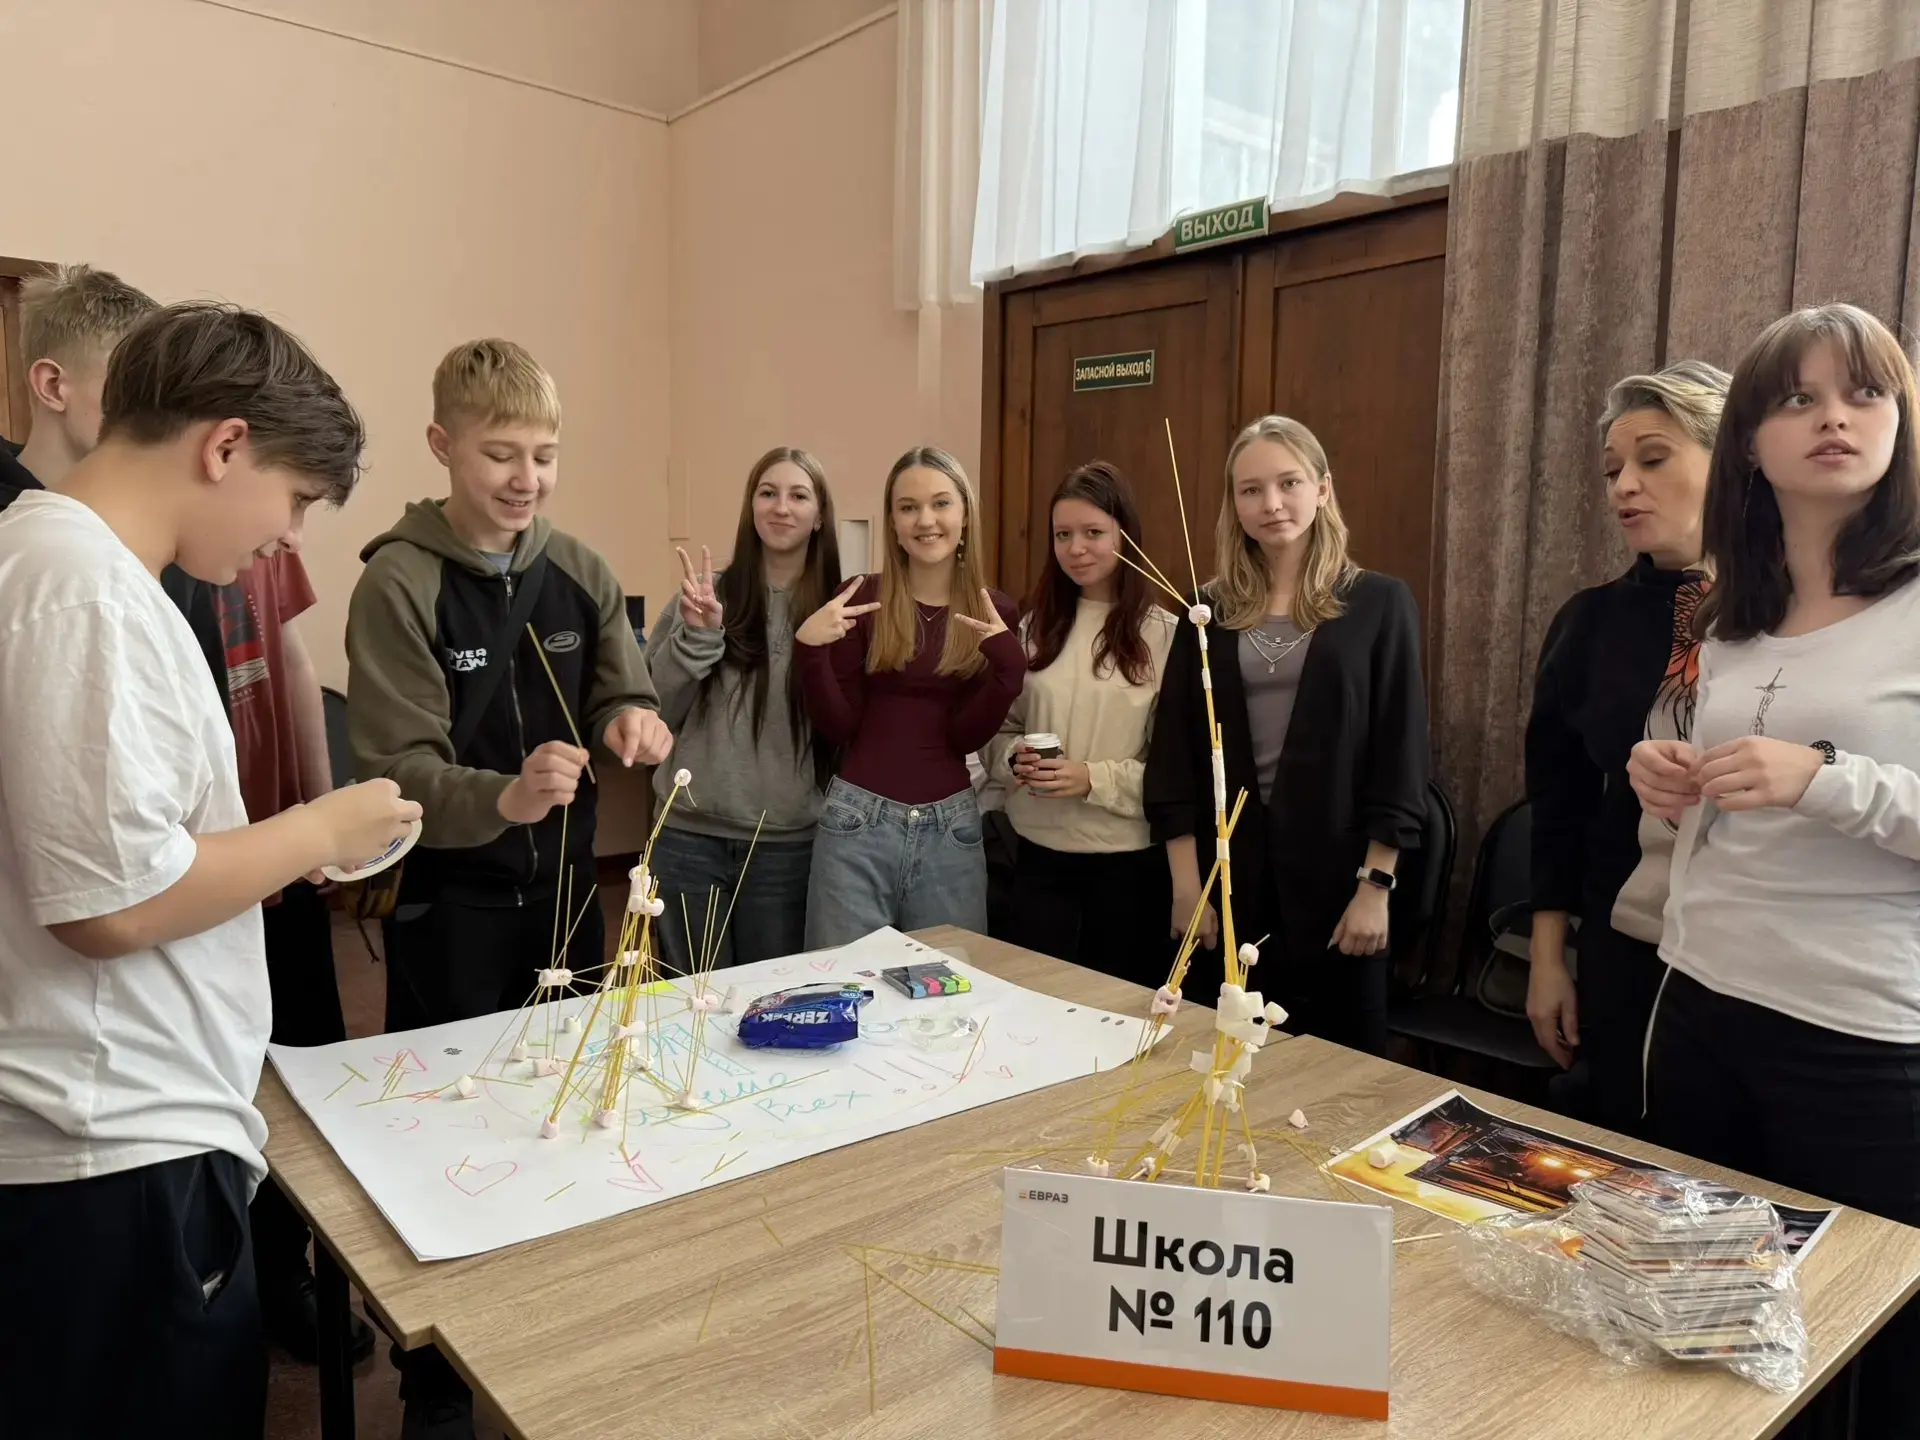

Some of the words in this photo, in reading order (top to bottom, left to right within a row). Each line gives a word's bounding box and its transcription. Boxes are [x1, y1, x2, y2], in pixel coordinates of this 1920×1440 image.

[1181, 205, 1254, 242] ВЫХОД
[1076, 362, 1115, 381] ЗАПАСНОЙ
[1116, 361, 1144, 377] ВЫХОД
[1145, 359, 1151, 374] 6
[1029, 1190, 1069, 1204] ЕВРАЗ
[1093, 1216, 1295, 1285] Школа
[1108, 1285, 1175, 1336] №
[1194, 1297, 1272, 1349] 110
